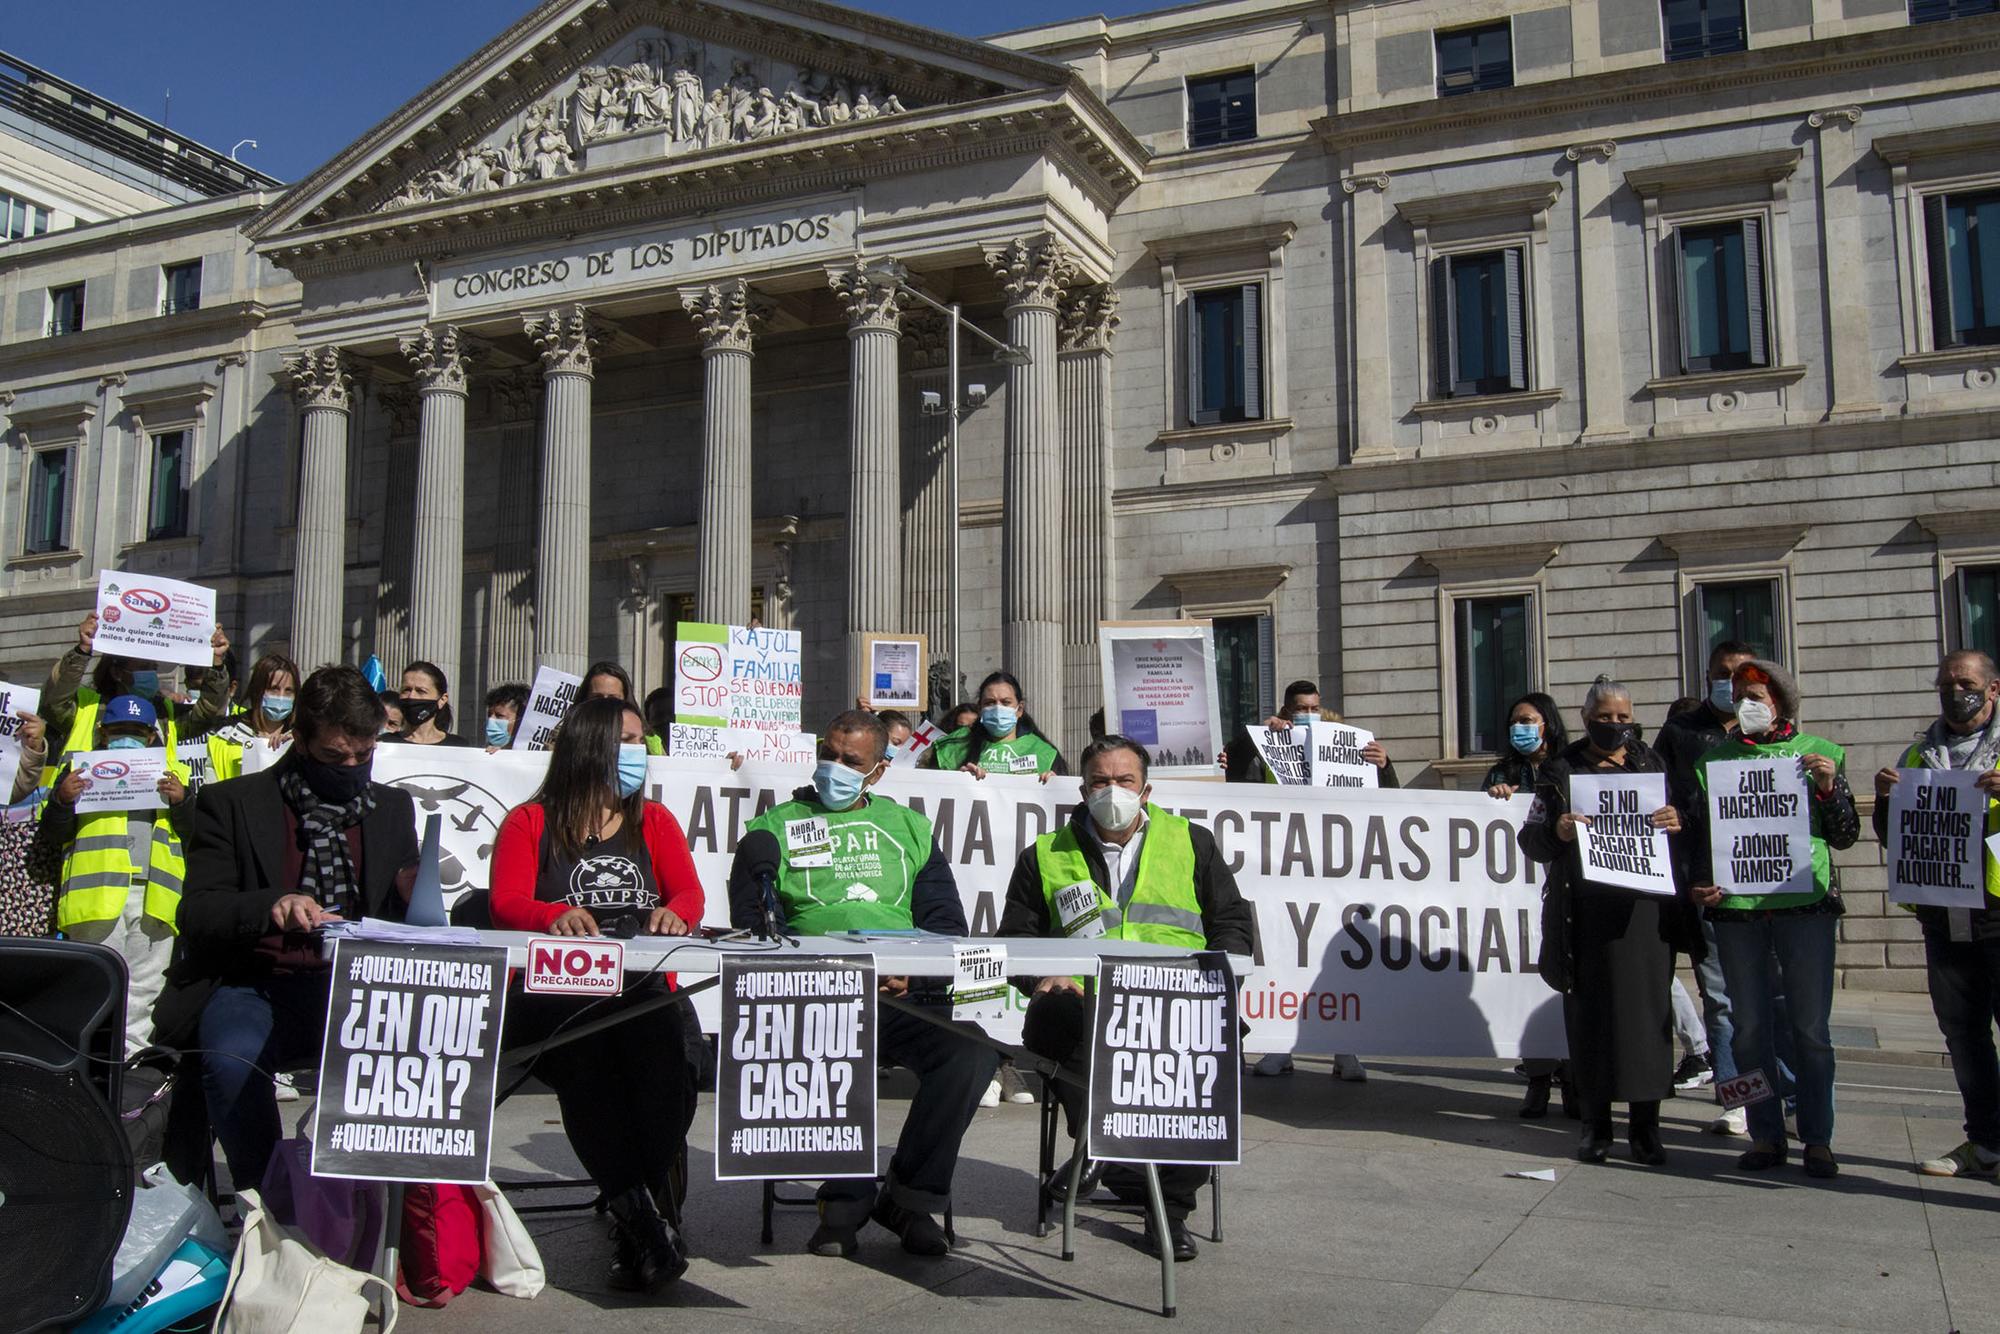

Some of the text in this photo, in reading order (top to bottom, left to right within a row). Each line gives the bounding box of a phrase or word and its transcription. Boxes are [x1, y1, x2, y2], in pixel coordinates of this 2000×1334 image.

[454, 217, 830, 299] CONGRESO DE LOS DIPUTADOS
[100, 632, 170, 648] miles de familias
[102, 624, 126, 633] Sareb
[128, 628, 154, 637] quiere
[156, 630, 196, 643] desauciar
[732, 628, 798, 653] KAJOL
[756, 650, 769, 664] Y
[733, 660, 800, 682] FAMILIA
[555, 681, 580, 704] ¿QU
[681, 686, 728, 708] STOP
[731, 678, 749, 694] SE
[731, 695, 752, 707] POR
[755, 697, 769, 709] EL
[732, 706, 740, 718] A
[744, 708, 757, 719] LA
[672, 724, 718, 742] SR JOSE
[730, 719, 752, 730] HAY
[763, 733, 791, 749] NO
[1264, 729, 1291, 746] SI NO
[1332, 729, 1358, 748] ¿QUÉ
[1262, 744, 1305, 762] PODEMOS
[1319, 745, 1369, 766] HACEMOS
[1294, 762, 1311, 778] LOS
[1738, 768, 1776, 798] ¿QUÉ
[1598, 790, 1638, 814] SI NO
[1718, 794, 1799, 820] HACEMOS?
[1916, 786, 1957, 811] SI NO
[790, 821, 816, 837] AHORA
[1584, 814, 1655, 837] PODEMOS
[1901, 809, 1971, 838] PODEMOS
[802, 833, 812, 844] LA
[814, 828, 826, 842] LEY
[830, 830, 879, 854] PAH
[1589, 834, 1657, 858] PAGAR EL
[1732, 832, 1790, 859] ¿DÓNDE
[832, 853, 880, 864] PLATAFORMA
[1450, 818, 1551, 884] PO
[1902, 835, 1968, 864] PAGAR EL
[1588, 849, 1665, 878] ALQUILER...
[1730, 859, 1793, 883] VAMOS?
[1896, 860, 1975, 890] ALQUILER...
[574, 890, 644, 906] PAVPS
[1060, 886, 1082, 909] AHORA
[1071, 892, 1093, 914] LA LEY
[1286, 902, 1320, 968] Y
[1340, 902, 1542, 975] SOCIAL
[350, 955, 492, 991] #QUEDATEENCASA
[534, 948, 616, 977] NO+
[974, 965, 985, 981] LA
[988, 961, 1003, 978] LEY
[533, 975, 615, 989] PRECARIEDAD
[735, 970, 864, 1000] #QUEDATEENCASA
[1112, 964, 1227, 994] #QUEDATEENCASA
[1238, 981, 1360, 1021] uieren
[340, 988, 490, 1060] ¿EN QUÉ
[732, 998, 864, 1063] ¿EN QUÉ
[1105, 994, 1227, 1056] ¿EN QUÉ
[344, 1053, 472, 1121] CASA?
[740, 1061, 853, 1121] CASA?
[1111, 1050, 1218, 1109] CASA?
[1102, 1112, 1228, 1140] #QUEDATEENCASA
[331, 1122, 475, 1157] #QUEDATEENCASA
[731, 1126, 864, 1155] #QUEDATEENCASA
